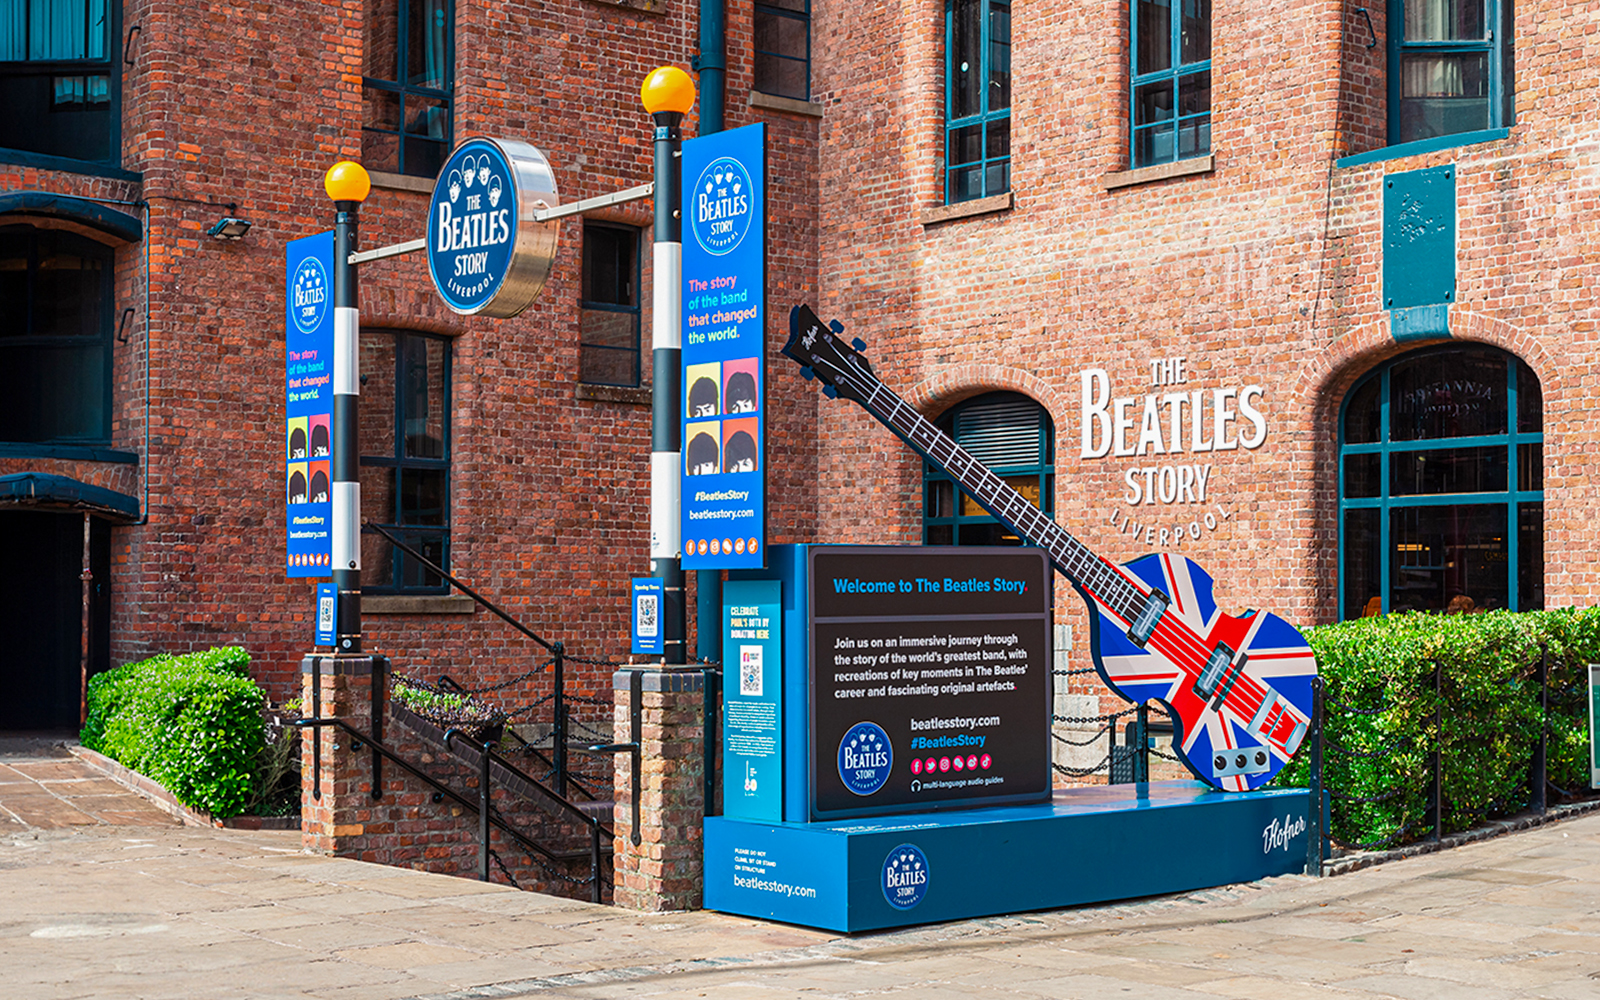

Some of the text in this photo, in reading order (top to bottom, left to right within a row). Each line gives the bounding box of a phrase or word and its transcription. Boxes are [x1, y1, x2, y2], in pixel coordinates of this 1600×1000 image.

[717, 188, 727, 197] THE
[466, 194, 481, 210] THE
[699, 193, 747, 222] BEATLES
[437, 201, 509, 252] BEATLES
[711, 219, 733, 235] STORY
[454, 252, 488, 276] STORY
[448, 273, 494, 297] LIVERPOOL
[689, 275, 736, 292] The story
[295, 284, 324, 307] BEATLES
[688, 289, 747, 310] of the band
[688, 305, 756, 327] that changed
[688, 325, 740, 344] the world.
[289, 350, 318, 361] The story
[289, 360, 324, 374] of the band
[1150, 356, 1186, 386] THE
[289, 373, 329, 388] that changed
[289, 392, 298, 402] the
[1080, 368, 1268, 460] BEATLES
[1125, 464, 1211, 506] STORY
[695, 490, 749, 501] #BeatlesStory
[690, 509, 754, 520] beatlesstory.com
[1109, 503, 1231, 546] LIVERPOOL
[833, 578, 1028, 594] Welcome to The Beatles Story.
[731, 607, 759, 615] CELEBRATE
[834, 634, 1018, 649] Join us on an immersive journey through
[834, 648, 1027, 666] the story of the world's greatest band, with
[834, 664, 1028, 681] recreations of key moments in The Beatles'
[834, 680, 1017, 698] career and fascinating original artefacts.
[911, 716, 1000, 730] beatlesstory.com
[911, 734, 986, 749] #BeatlesStory
[845, 747, 887, 769] BEATLES
[855, 769, 875, 779] STORY
[923, 780, 966, 789] multi-language
[985, 777, 1003, 785] guides
[887, 867, 925, 887] BEATLES
[734, 874, 816, 898] beatlesstory.com
[897, 887, 915, 897] STORY
